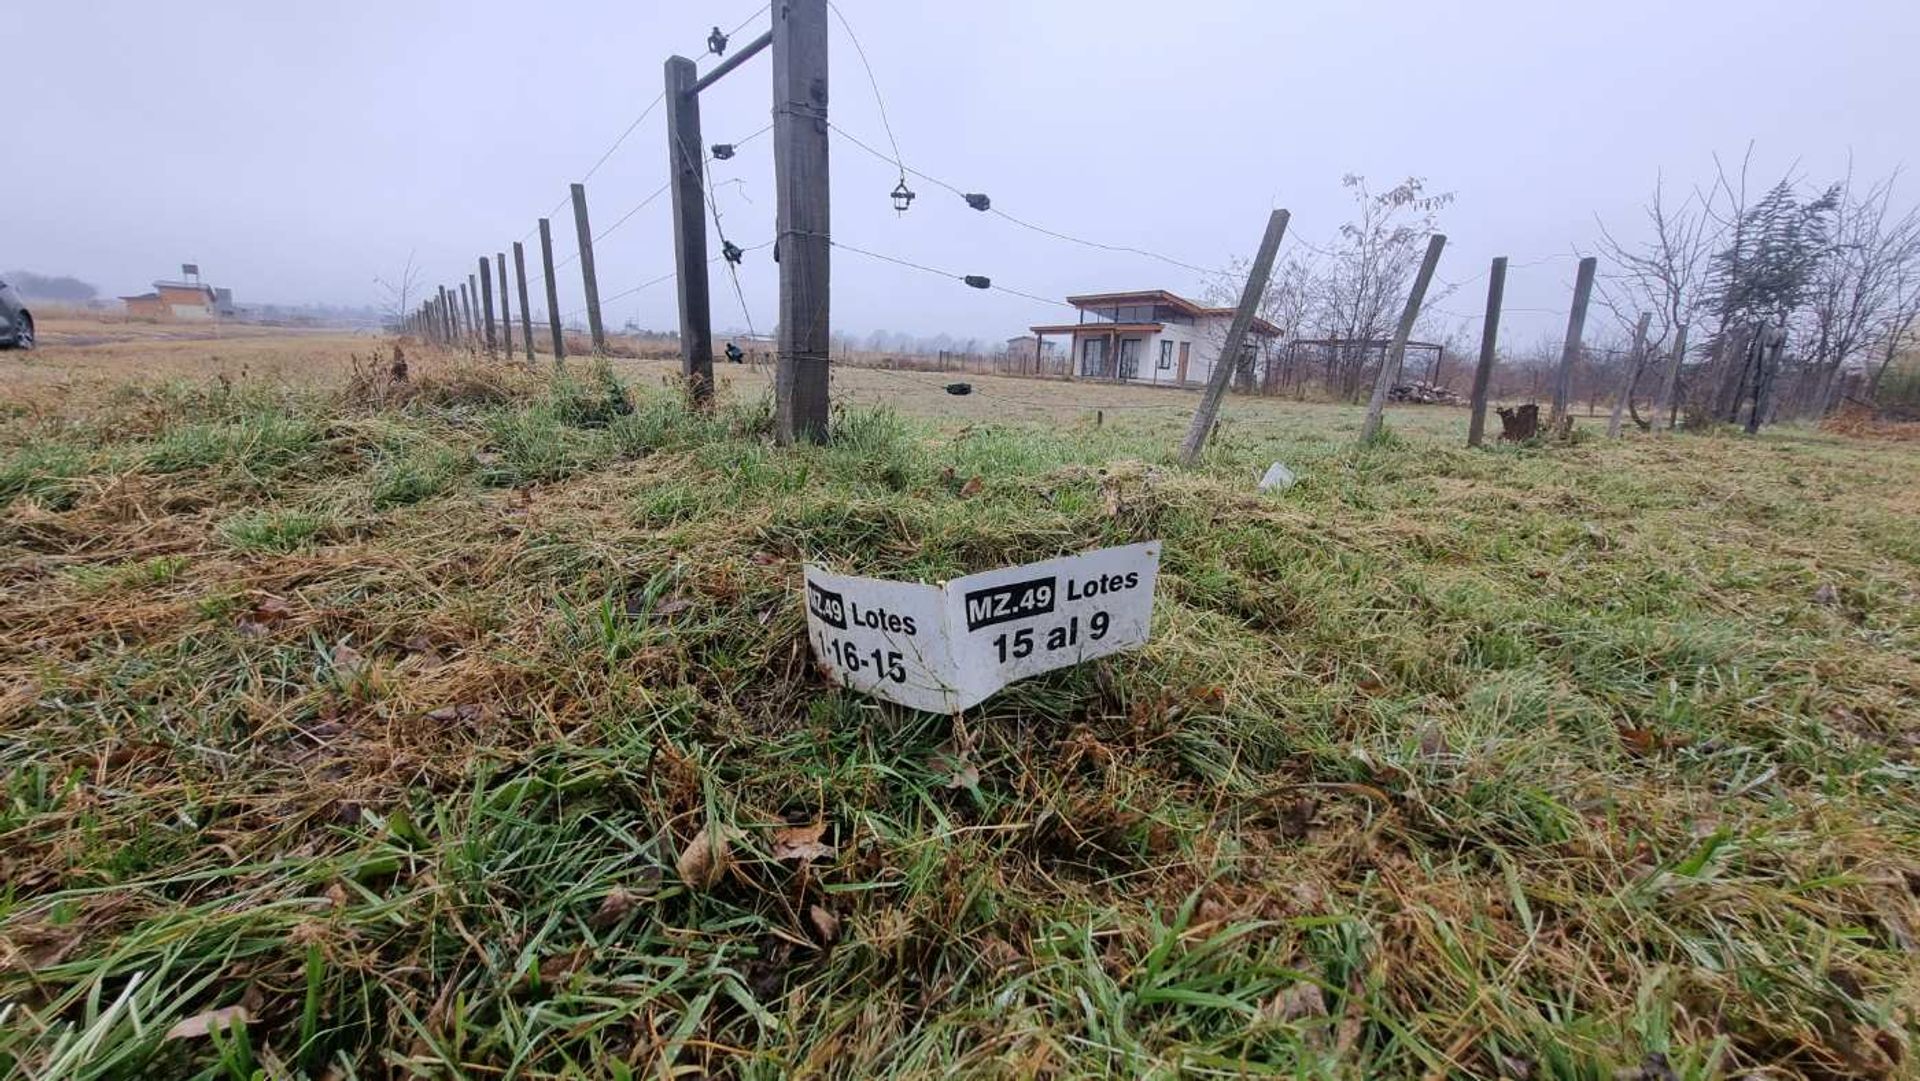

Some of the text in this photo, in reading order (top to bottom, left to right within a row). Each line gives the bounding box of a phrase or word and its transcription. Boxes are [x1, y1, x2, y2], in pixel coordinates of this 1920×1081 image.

[851, 601, 918, 636] Lotes
[967, 571, 1139, 624] MZ.49 Lotes
[992, 611, 1111, 664] 15 al 9
